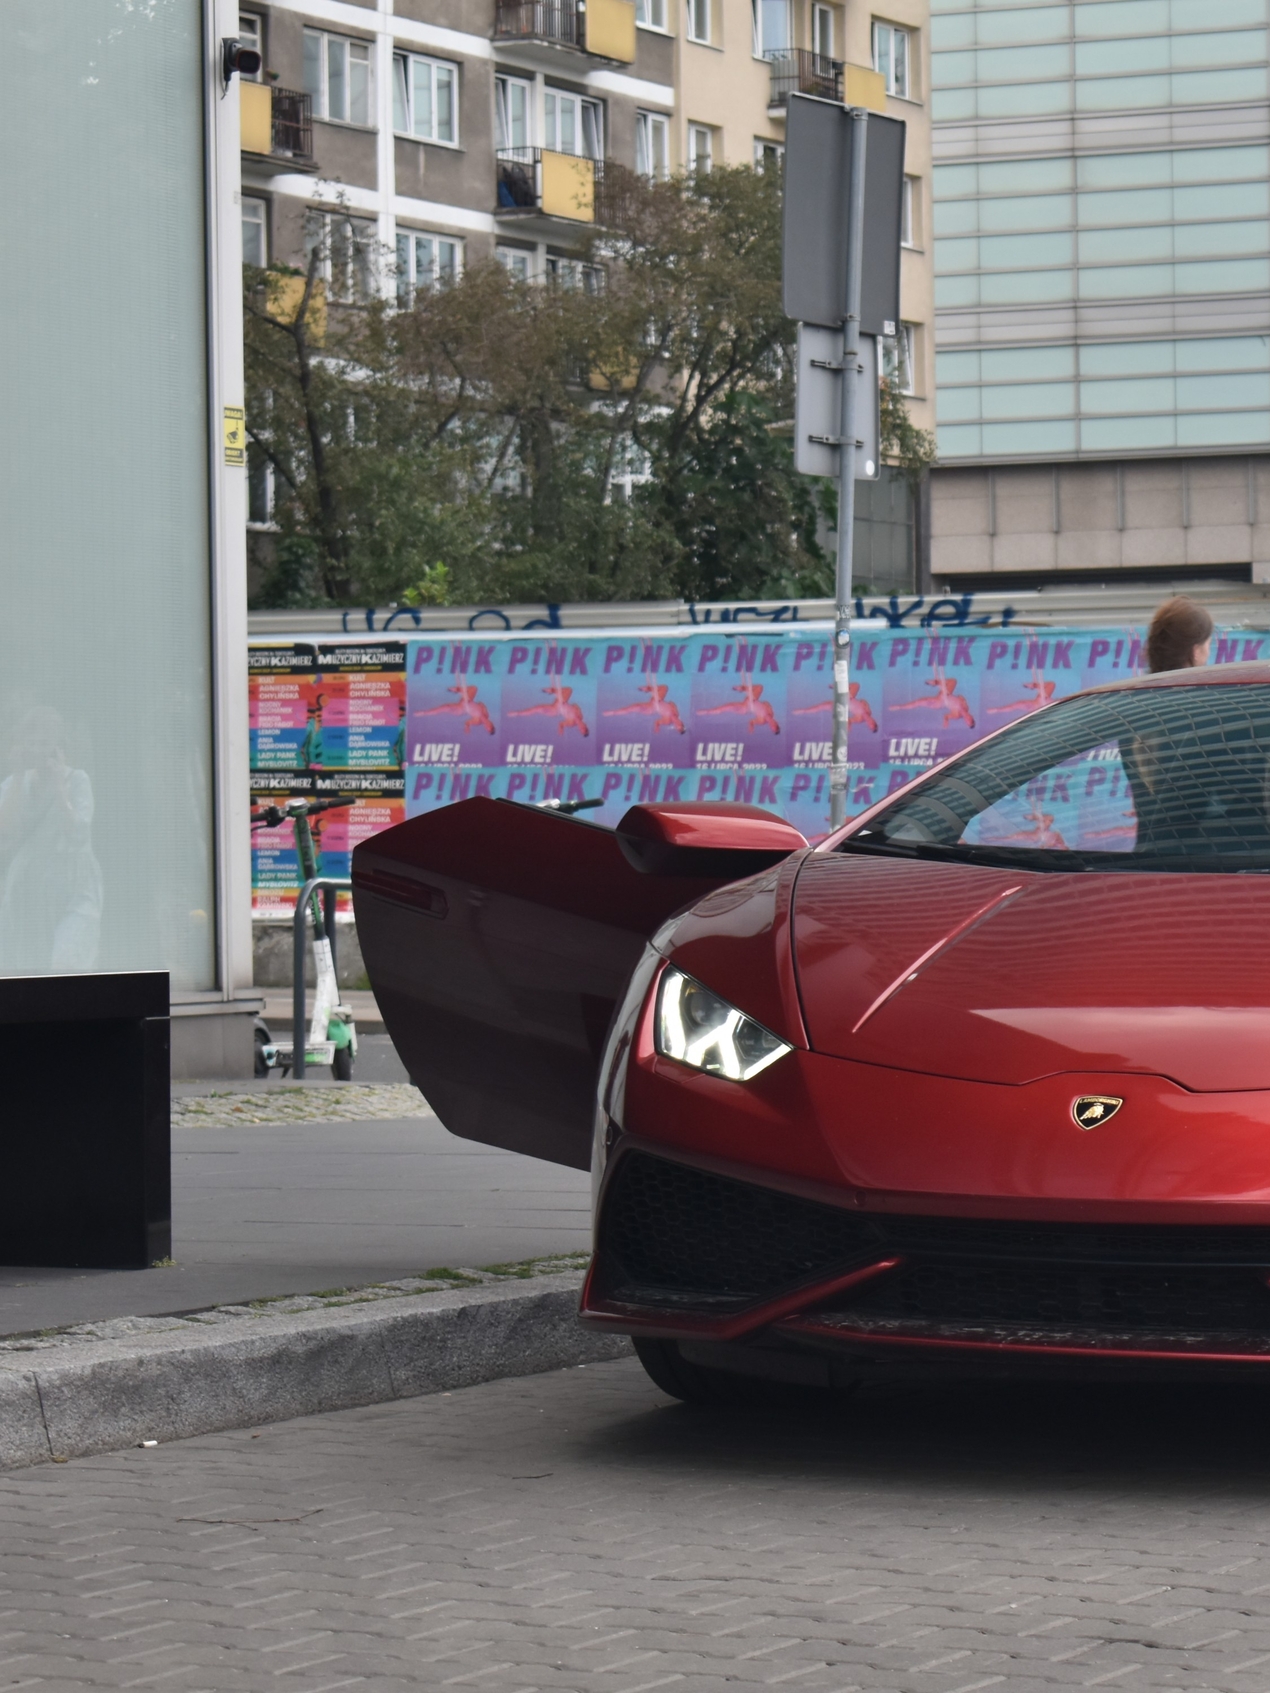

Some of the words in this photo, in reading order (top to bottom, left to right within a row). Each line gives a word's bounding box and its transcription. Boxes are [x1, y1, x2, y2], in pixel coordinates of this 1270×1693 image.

[271, 656, 312, 666] KAZIMIERZ
[318, 654, 360, 664] MUZYCZNY
[362, 652, 404, 664] KAZIMIERZ
[414, 645, 496, 675] P!NK
[508, 646, 593, 675] P!NK
[603, 644, 688, 673] P!NK
[698, 644, 783, 672] P!NK
[793, 641, 880, 672] P!K
[889, 636, 976, 667] P!NK
[986, 640, 1075, 670] P!NK
[1088, 639, 1149, 668] P!N
[1215, 638, 1264, 664] NK
[414, 743, 460, 762] LIVE!
[506, 744, 554, 762] LIVE!
[603, 743, 650, 762] LIVE!
[696, 742, 744, 762] LIVE!
[794, 742, 833, 761] LIVE
[889, 738, 938, 757] LIVE!
[317, 780, 360, 789] MUZYCZNY
[361, 779, 404, 789] KAZIMIERZ
[602, 772, 686, 802] P!NK
[696, 775, 782, 804] P!NK
